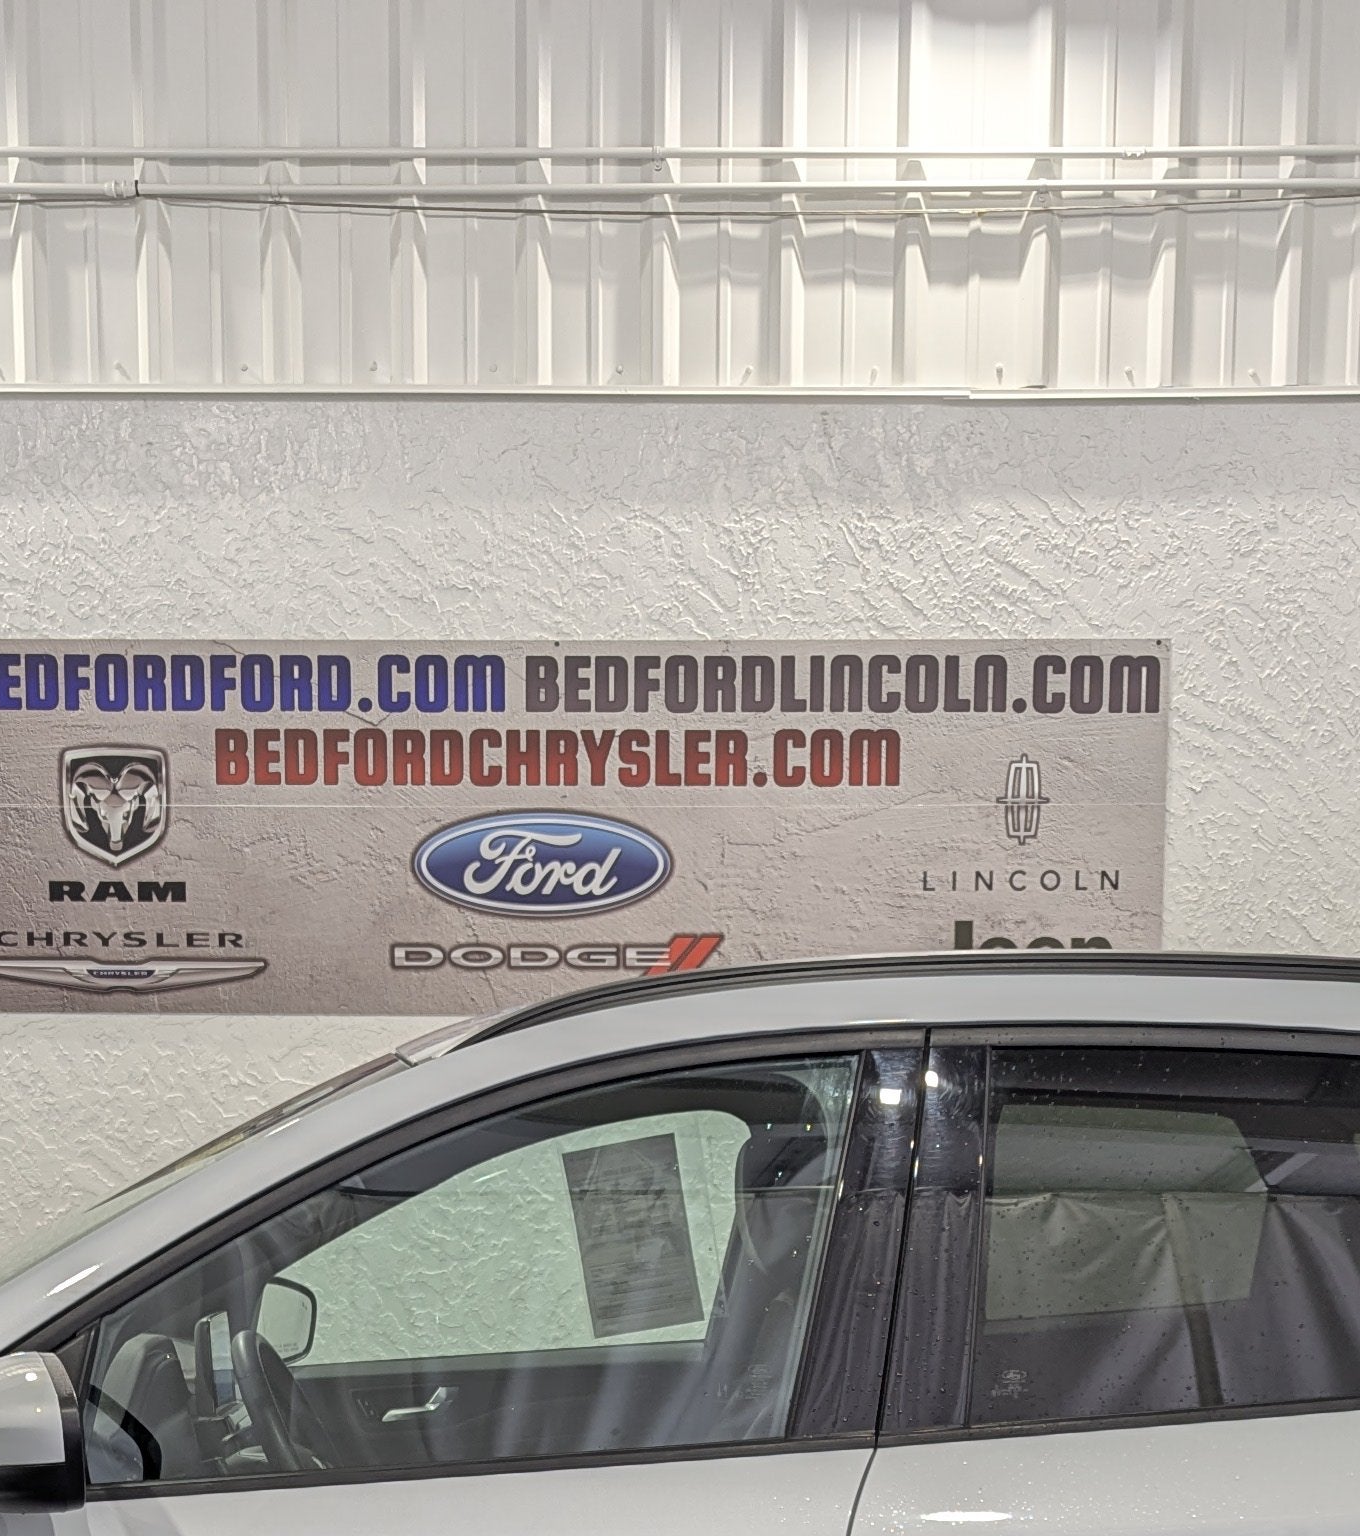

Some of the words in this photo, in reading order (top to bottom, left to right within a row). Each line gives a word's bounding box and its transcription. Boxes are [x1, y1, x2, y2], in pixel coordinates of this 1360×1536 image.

[525, 654, 1162, 714] BEDFORDLINCOLN.COM
[215, 728, 901, 788] BEDFORDCHRYSLER.COM
[463, 828, 623, 896] Ford
[922, 869, 1120, 892] LINCOLN
[48, 880, 188, 903] RAM
[391, 944, 673, 970] DODGE
